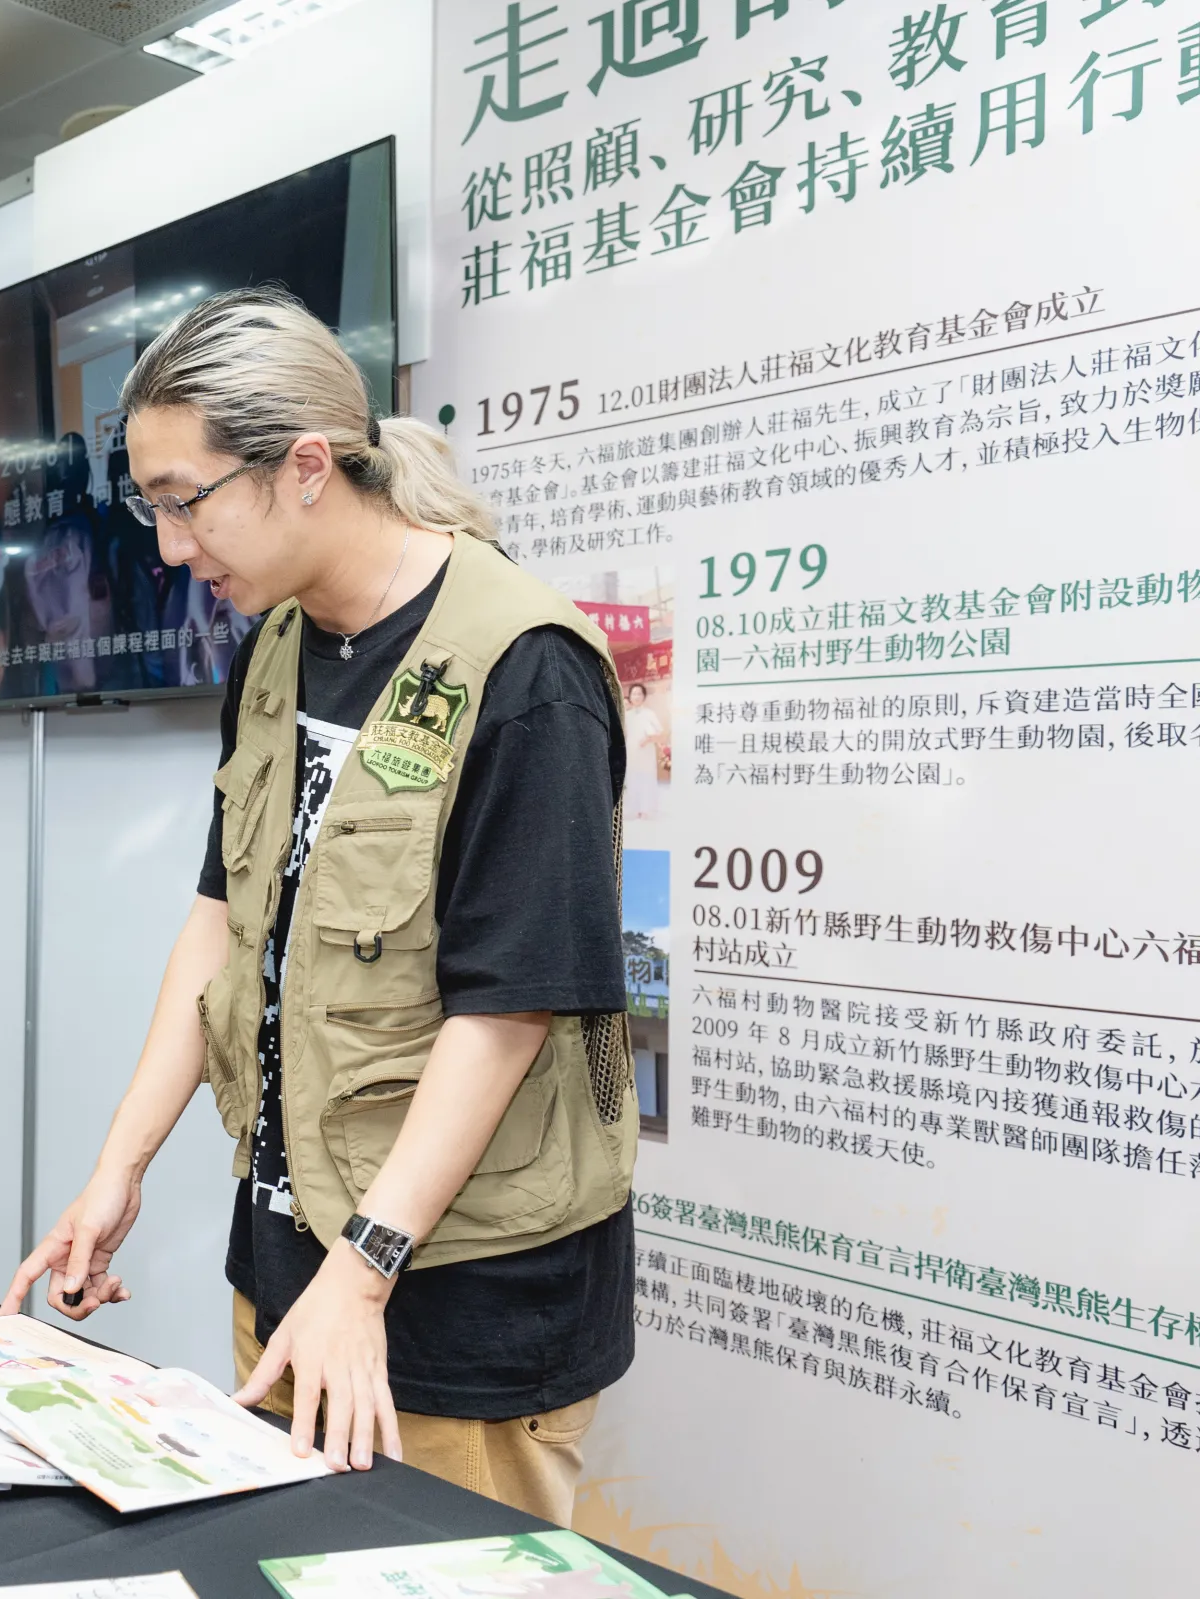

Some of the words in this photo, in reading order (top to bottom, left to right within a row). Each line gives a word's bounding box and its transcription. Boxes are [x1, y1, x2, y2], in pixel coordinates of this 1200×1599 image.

[461, 0, 1167, 232] 從照顧、研究、教育
[477, 379, 580, 437] 1975
[597, 285, 1105, 415] 12.01財團法人莊福文化教育基金會成立
[496, 407, 1200, 534] 青年，培育學術、運動與藝術教育領域的優秀人才，並積極投入生物
[698, 543, 829, 600] 1979
[695, 682, 1200, 725] 秉持尊重動物福祉的原則，斥資建造當時全
[373, 735, 397, 744] CHUANG
[399, 738, 411, 746] FOO
[412, 741, 442, 764] FOUNDATION
[695, 721, 1200, 755] 唯一且規模最大的開放式野生動物園，後取
[371, 750, 432, 777] 六福旅遊集團
[388, 765, 410, 779] TOURISM
[410, 774, 429, 785] GROUP
[693, 845, 824, 895] 2009
[692, 935, 798, 970] 村站成立
[692, 1016, 739, 1038] 2009
[749, 1021, 770, 1044] 年
[779, 1027, 791, 1045] 8
[635, 1246, 1200, 1415] 續正面臨棲地破壞的危機，莊福文化教育基金會
[635, 1276, 1200, 1453] 機構，共同簽署「臺灣黑熊復育合作保育宣言」，透
